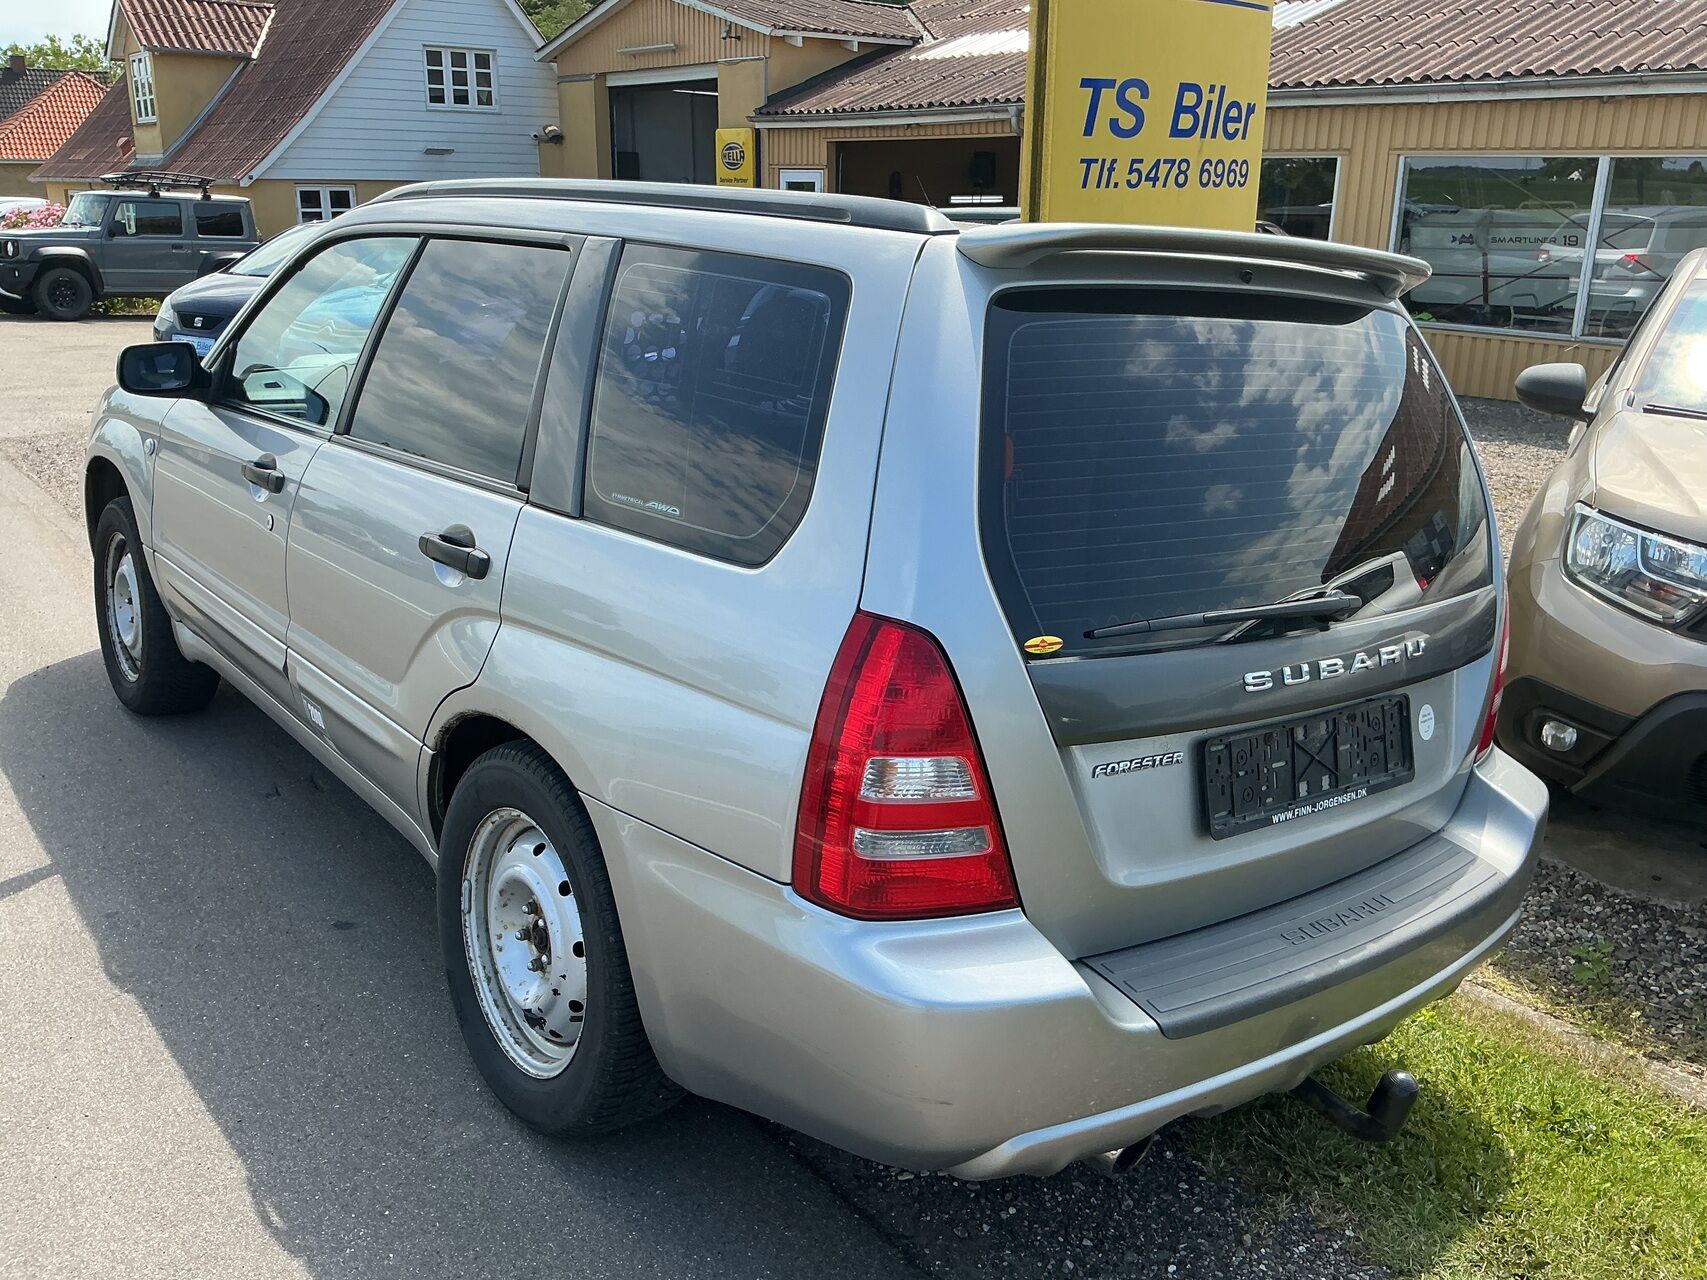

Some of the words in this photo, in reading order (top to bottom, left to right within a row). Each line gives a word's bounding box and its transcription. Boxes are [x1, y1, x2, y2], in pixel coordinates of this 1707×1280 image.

[1079, 77, 1150, 139] TS
[1168, 82, 1257, 141] Biler
[1079, 158, 1118, 189] Tlf.
[1125, 158, 1191, 190] 5478
[1198, 158, 1250, 188] 6969
[1490, 236, 1557, 244] SMARTLINER
[1562, 234, 1579, 247] 19
[645, 501, 680, 515] AWD
[1242, 638, 1427, 693] SUBARU
[1092, 751, 1184, 779] FORESTER
[1271, 787, 1368, 824] WWW.FINN-JORGENSEN.DK
[1280, 894, 1396, 946] SUBARU
